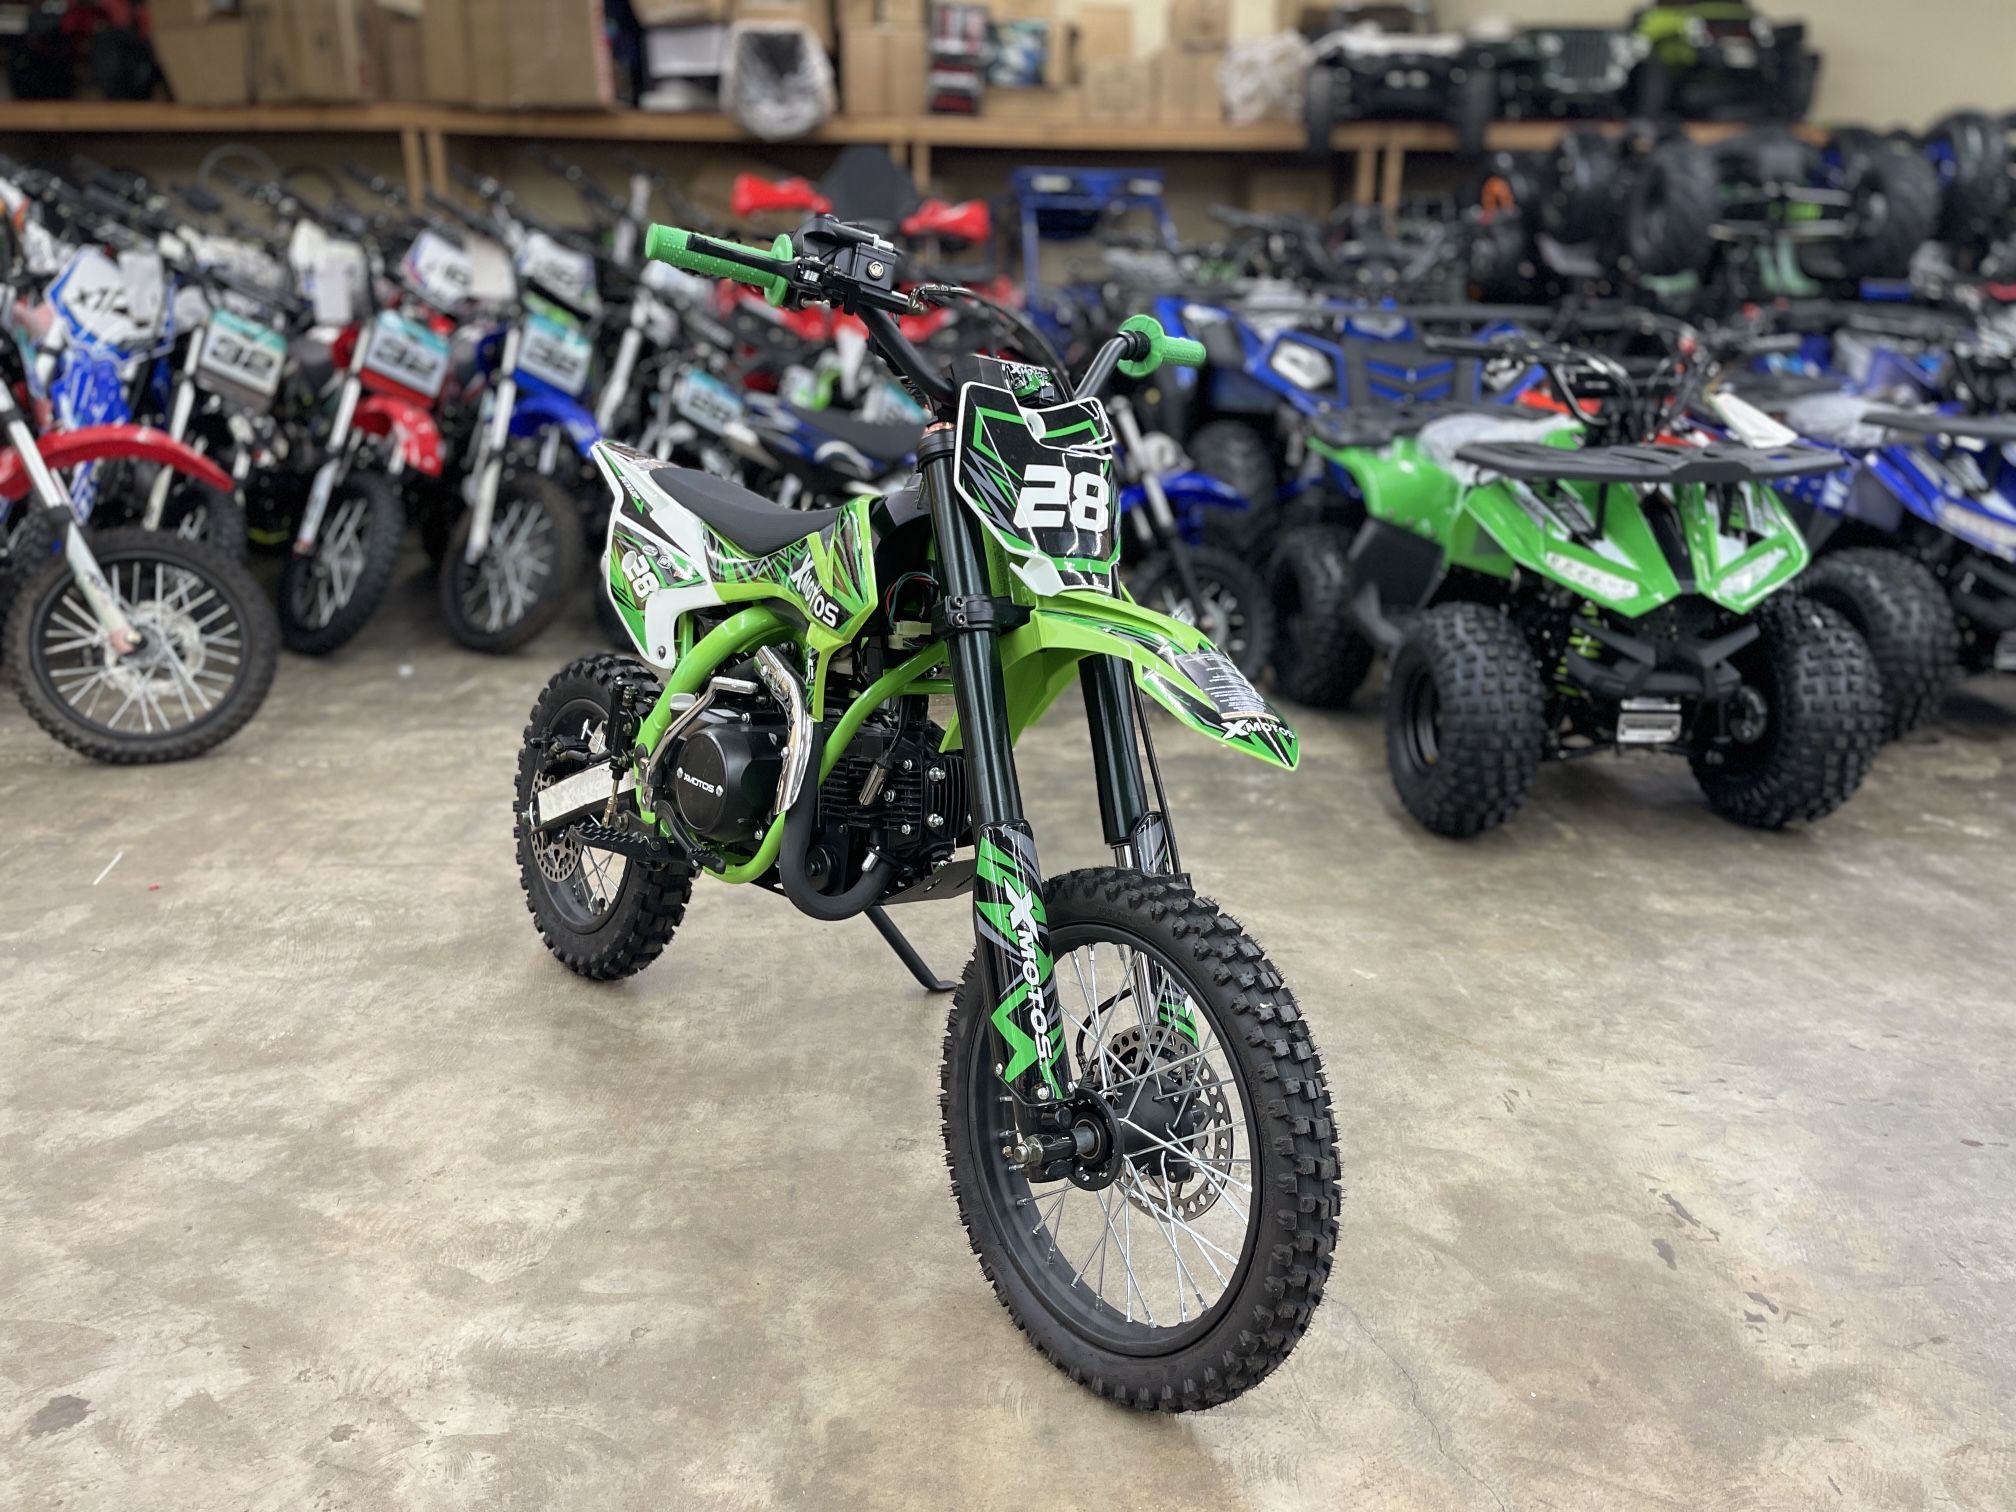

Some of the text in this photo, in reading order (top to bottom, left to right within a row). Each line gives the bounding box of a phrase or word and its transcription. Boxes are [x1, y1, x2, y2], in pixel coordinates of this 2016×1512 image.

[1013, 464, 1109, 532] 28
[622, 550, 660, 598] 28
[1220, 719, 1295, 739] XMOTOS
[684, 772, 714, 793] XMOTOS
[1003, 877, 1053, 1058] XMOTOS
